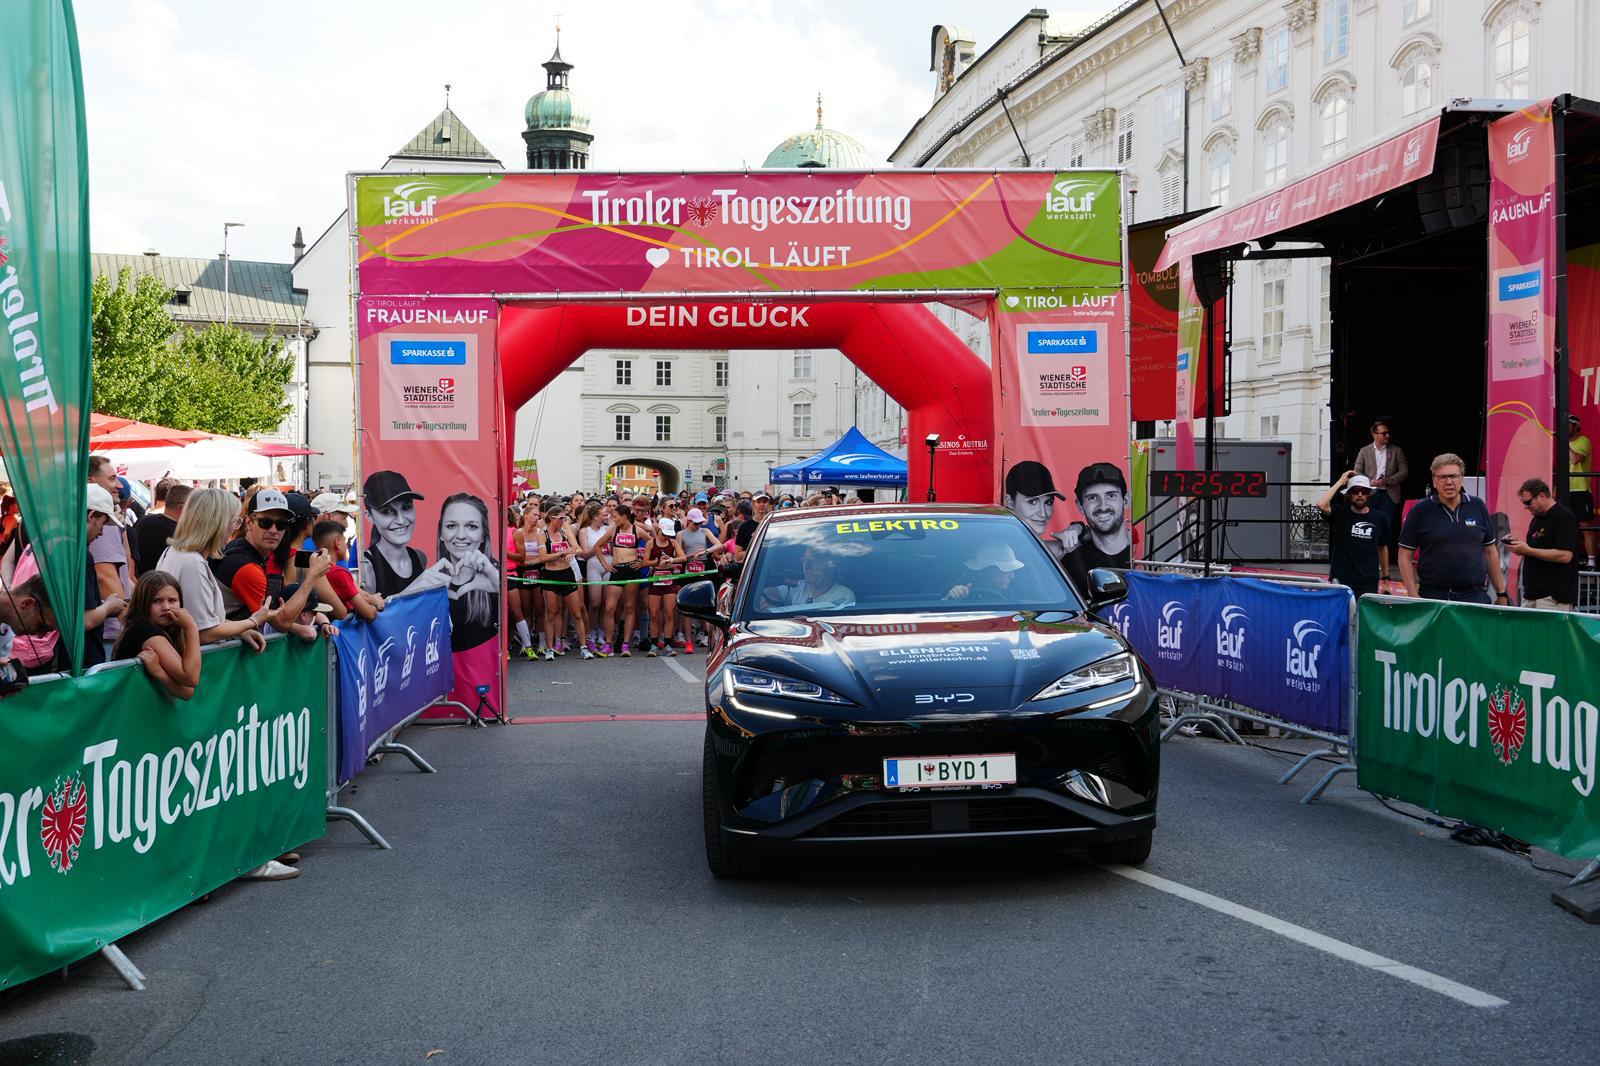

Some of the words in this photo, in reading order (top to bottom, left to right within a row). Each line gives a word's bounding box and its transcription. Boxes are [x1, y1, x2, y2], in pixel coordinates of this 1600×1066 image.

[1403, 144, 1421, 167] lauf
[1507, 136, 1531, 159] lauf
[383, 195, 437, 217] lauf
[582, 189, 687, 226] Tiroler
[711, 188, 911, 232] Tageszeitung
[1046, 192, 1095, 213] lauf
[680, 246, 760, 268] TIROL
[769, 241, 851, 268] LÄUFT
[1025, 296, 1067, 308] TIROL
[1072, 292, 1117, 308] LÄUFT
[367, 308, 489, 324] FRAUENLAUF
[626, 305, 699, 327] DEIN
[708, 302, 810, 328] GLÜCK
[1508, 319, 1532, 331] WIENER
[1038, 338, 1079, 346] SPARKASSE
[402, 349, 447, 357] SPARKASSE
[403, 386, 438, 394] WIENER
[1040, 381, 1087, 389] STÄDTISCHE
[403, 393, 455, 402] STÄDTISCHE
[392, 420, 416, 430] Tiroler
[962, 439, 988, 448] AUSTRIA
[1163, 472, 1263, 495] 17:25:22
[836, 519, 960, 535] ELEKTRO
[1351, 525, 1373, 536] lauf
[1158, 619, 1182, 650] lauf
[1216, 624, 1245, 659] lauf
[879, 645, 989, 657] ELLENSOHN
[908, 651, 963, 659] Innsbruck
[1286, 638, 1322, 679] lauf
[888, 655, 988, 665] www.ellensohn.at
[915, 693, 975, 704] BYD
[1374, 649, 1487, 749] Tiroler
[83, 703, 311, 854] Tageszeitung
[938, 760, 975, 781] BYD
[979, 760, 988, 780] 1
